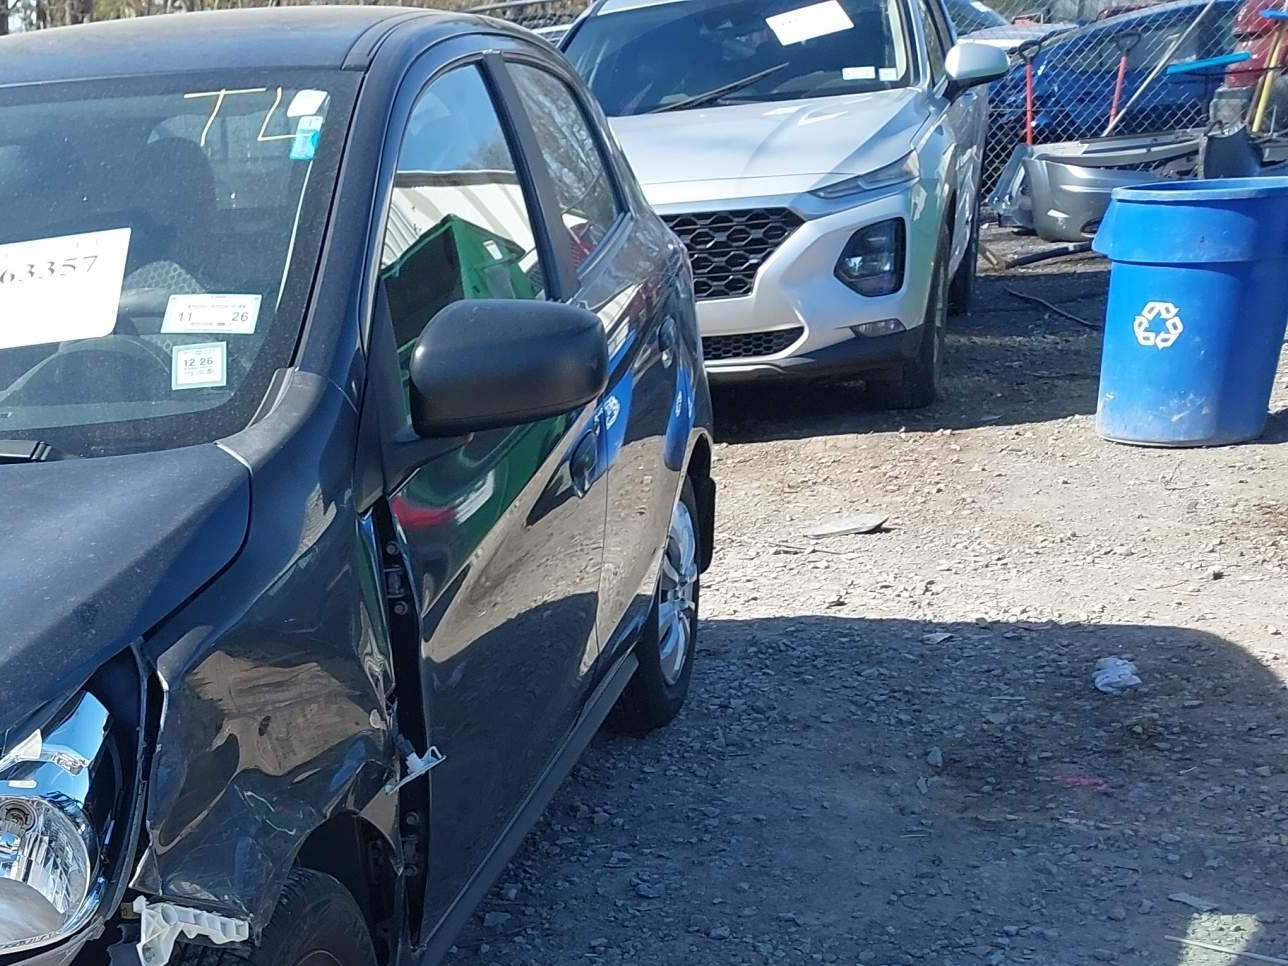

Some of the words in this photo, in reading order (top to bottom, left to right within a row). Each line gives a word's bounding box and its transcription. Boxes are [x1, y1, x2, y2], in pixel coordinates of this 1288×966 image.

[178, 311, 193, 321] 11
[231, 311, 249, 322] 26
[182, 358, 196, 367] 12
[199, 356, 214, 366] 26
